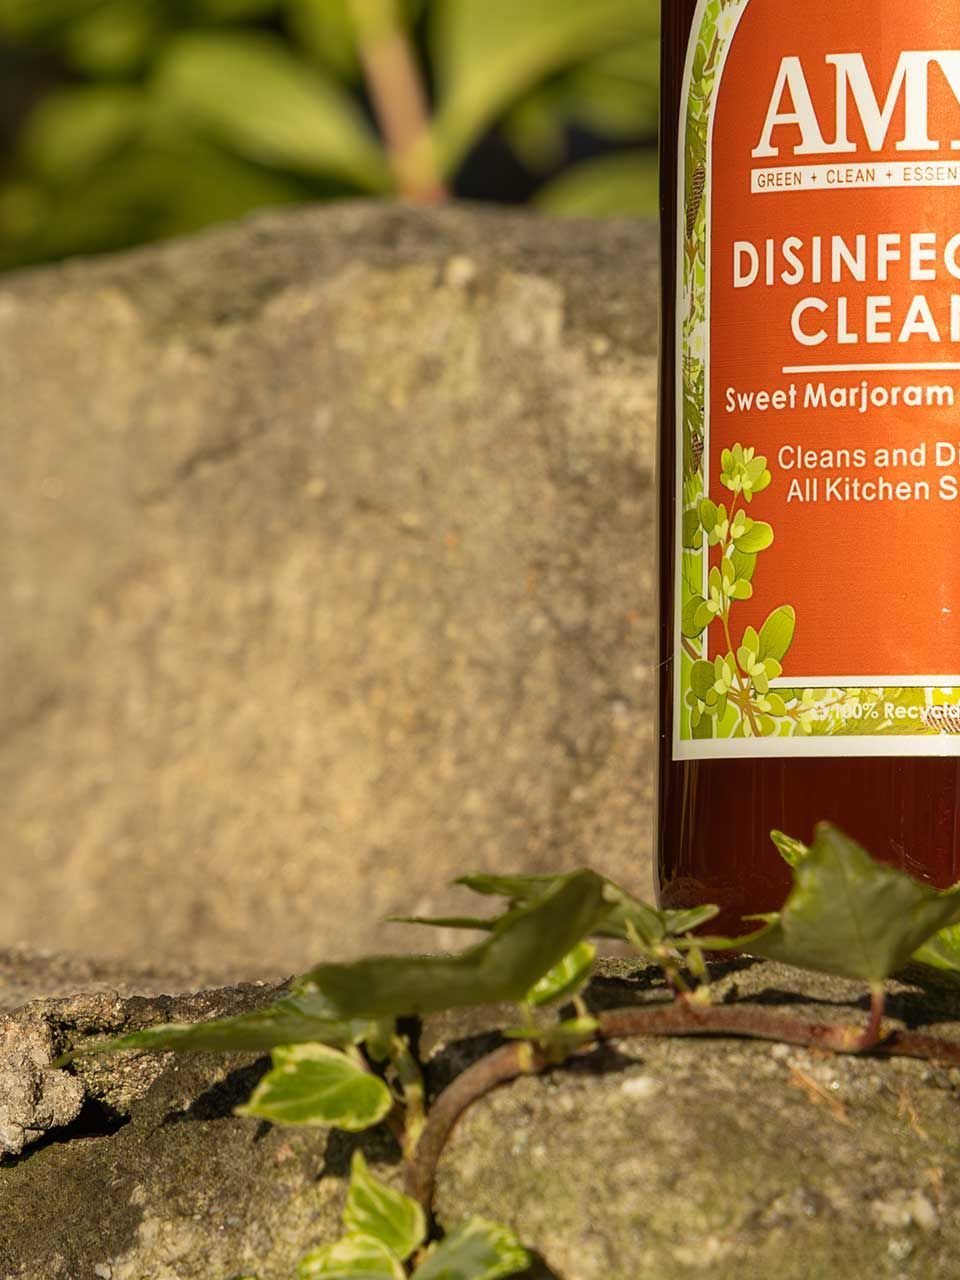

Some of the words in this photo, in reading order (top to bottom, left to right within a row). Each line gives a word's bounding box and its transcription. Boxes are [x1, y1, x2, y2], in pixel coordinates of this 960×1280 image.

[757, 172, 802, 188] GREEN
[826, 169, 876, 184] CLEAN
[725, 383, 797, 412] Sweet
[803, 380, 955, 413] Marjoram
[778, 445, 867, 469] Cleans
[874, 442, 926, 468] and
[787, 478, 818, 502] All
[825, 476, 930, 501] Kitchen
